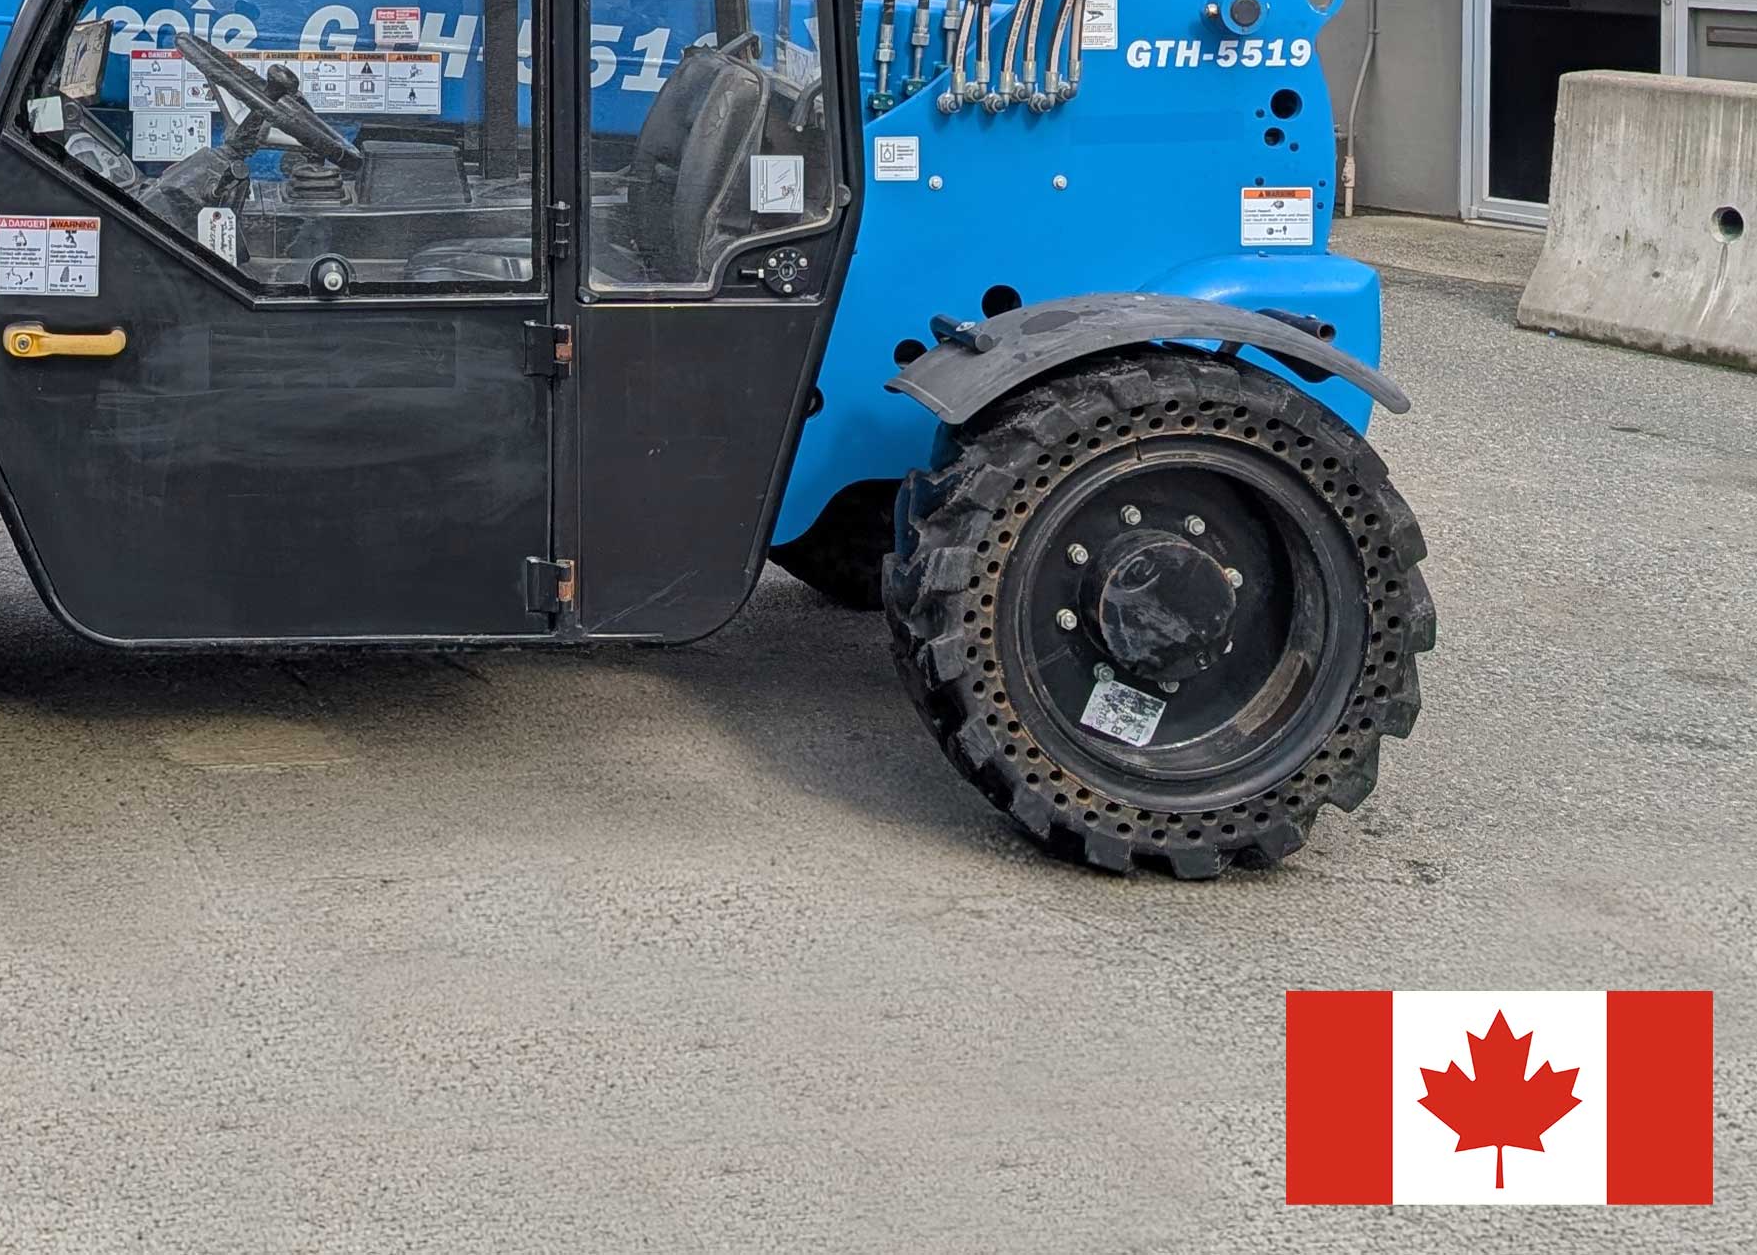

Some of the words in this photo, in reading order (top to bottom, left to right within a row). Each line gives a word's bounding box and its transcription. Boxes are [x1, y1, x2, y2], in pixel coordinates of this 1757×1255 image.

[1126, 39, 1312, 68] GTH-5519
[8, 219, 45, 228] DANGER
[56, 220, 96, 229] WARNING
